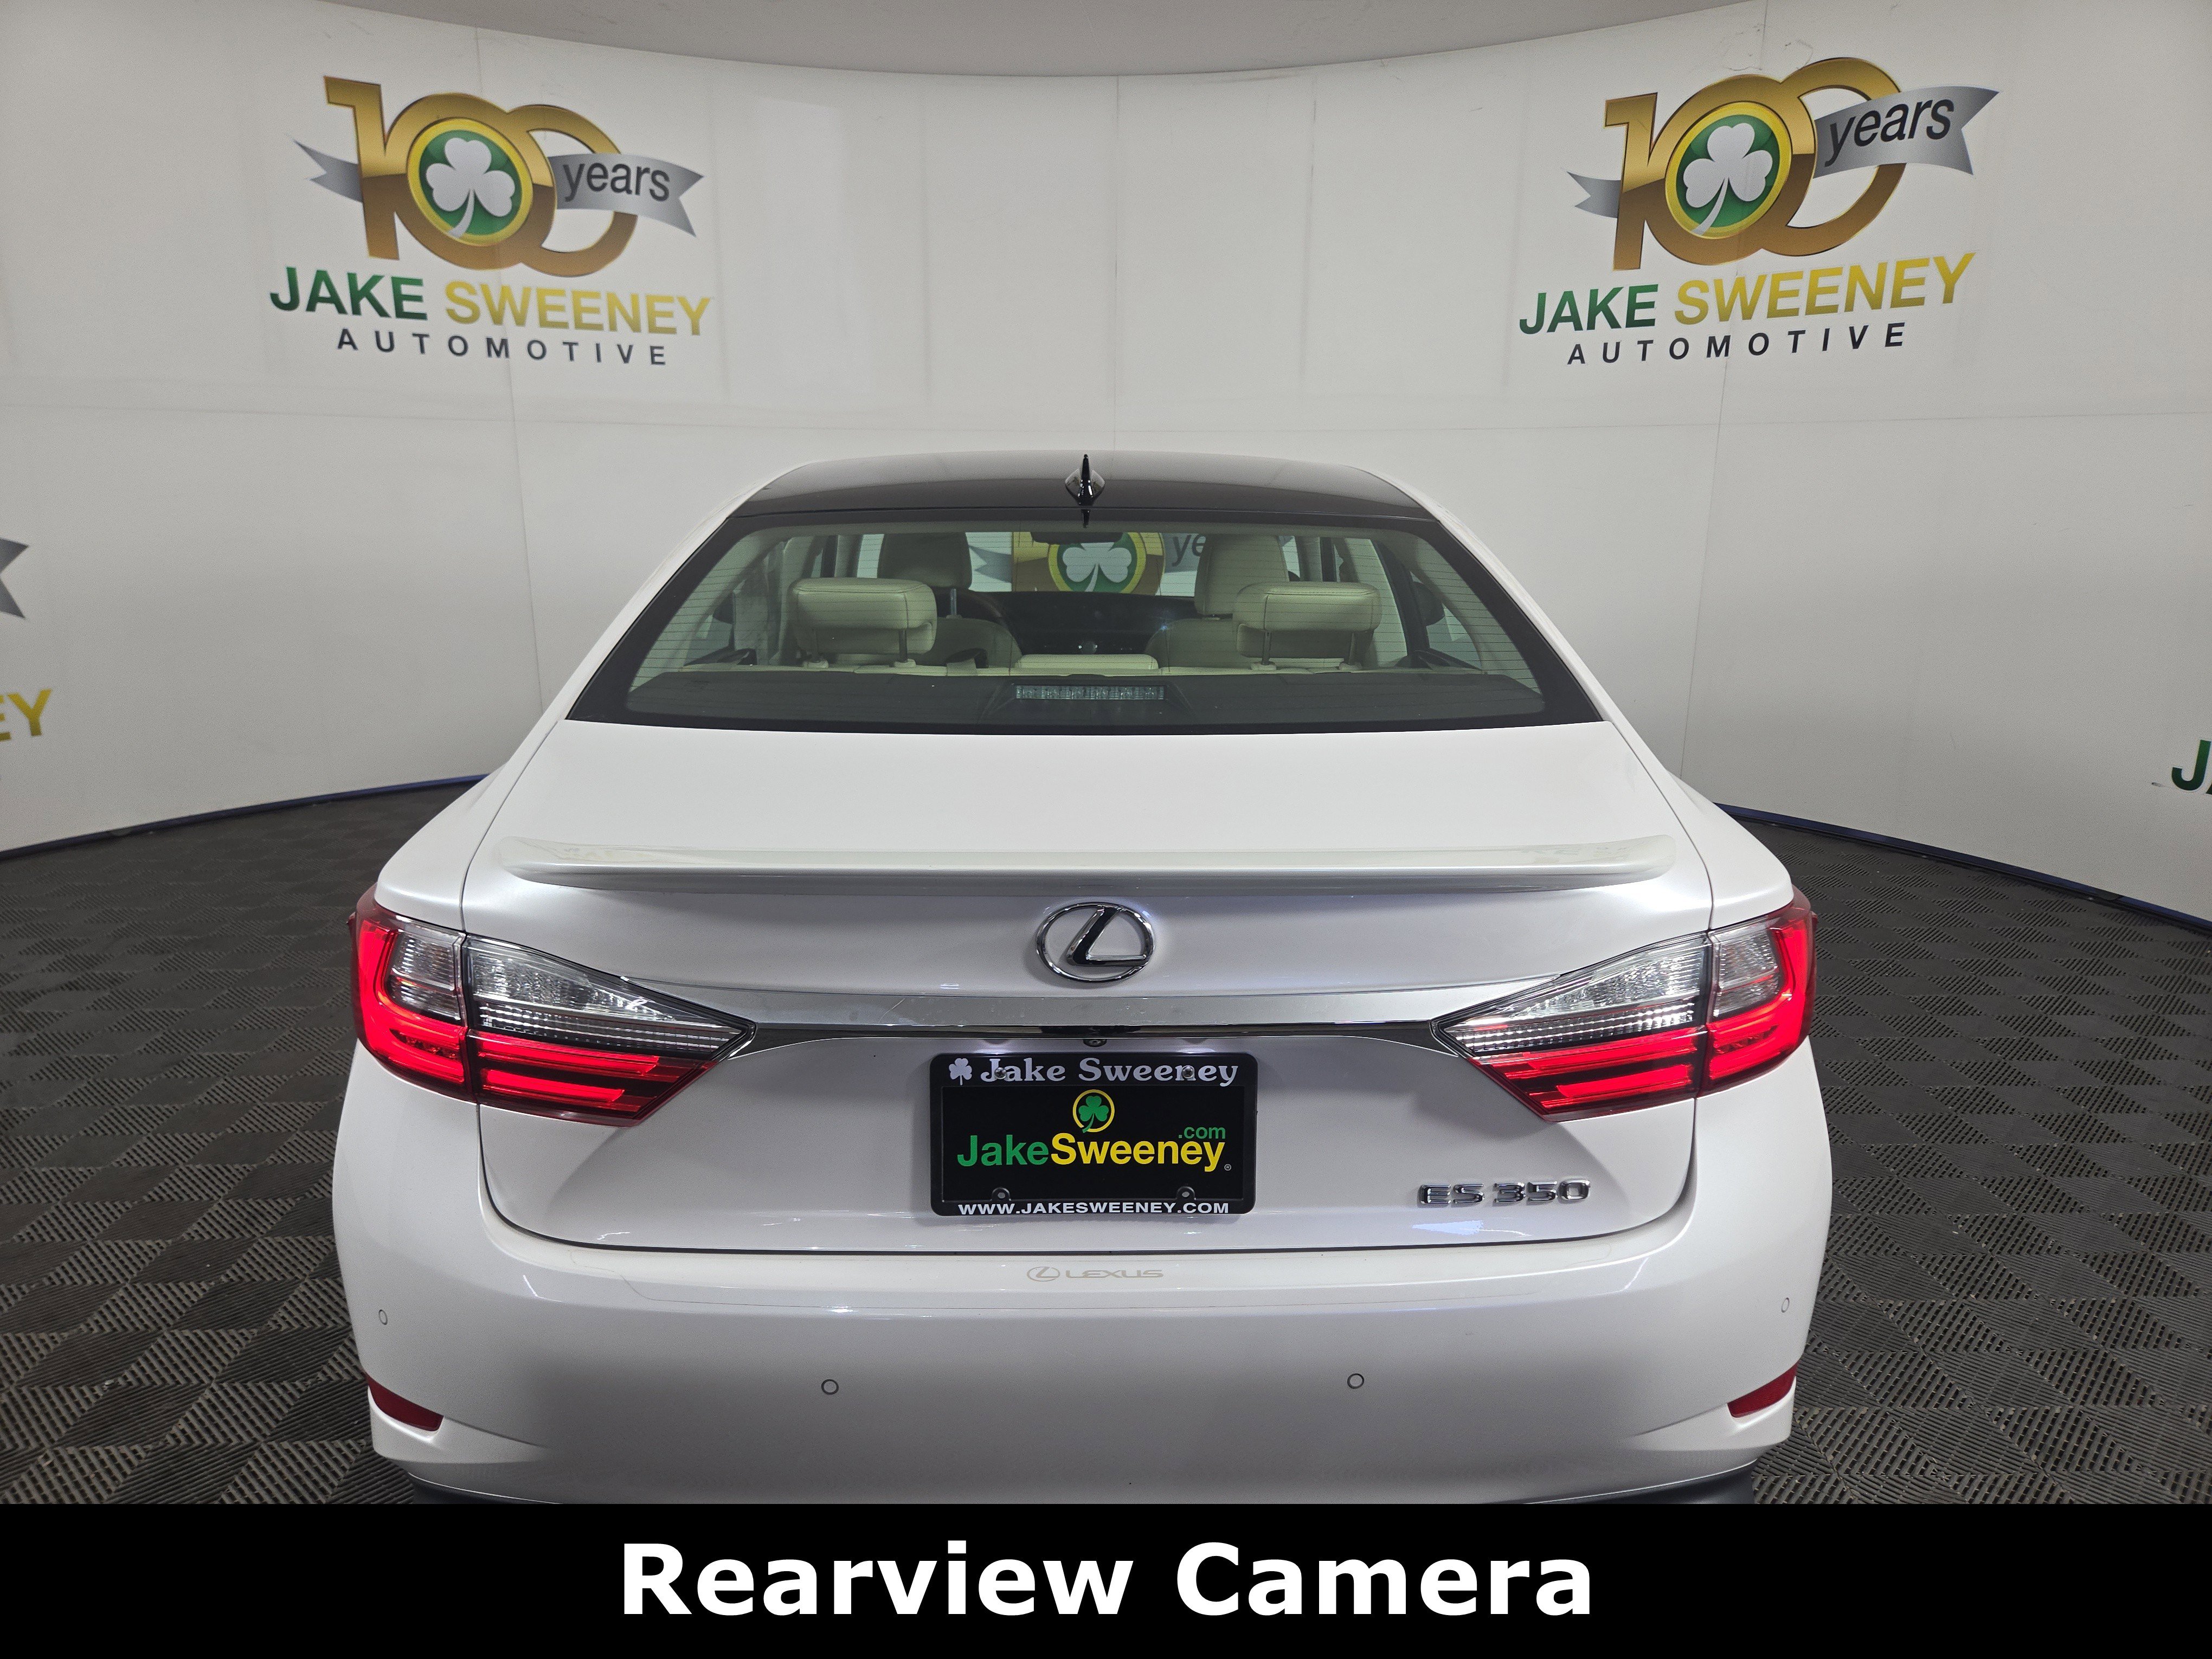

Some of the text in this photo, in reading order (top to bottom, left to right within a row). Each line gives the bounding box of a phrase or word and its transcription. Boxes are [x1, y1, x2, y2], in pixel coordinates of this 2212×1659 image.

[1824, 98, 1955, 168] years
[562, 159, 670, 202] years
[269, 266, 711, 336] JAKE SWEENEY
[1519, 252, 1976, 335] JAKE SWEENEY
[337, 328, 666, 365] AUTOMOTIVE
[1566, 321, 1906, 365] AUTOMOTIVE
[980, 1057, 1239, 1087] Jake Sweeney
[958, 1202, 1230, 1216] WWW.JAKESWEENEY.COM
[1417, 1179, 1591, 1207] ES 350
[1065, 1270, 1164, 1279] LEXUS
